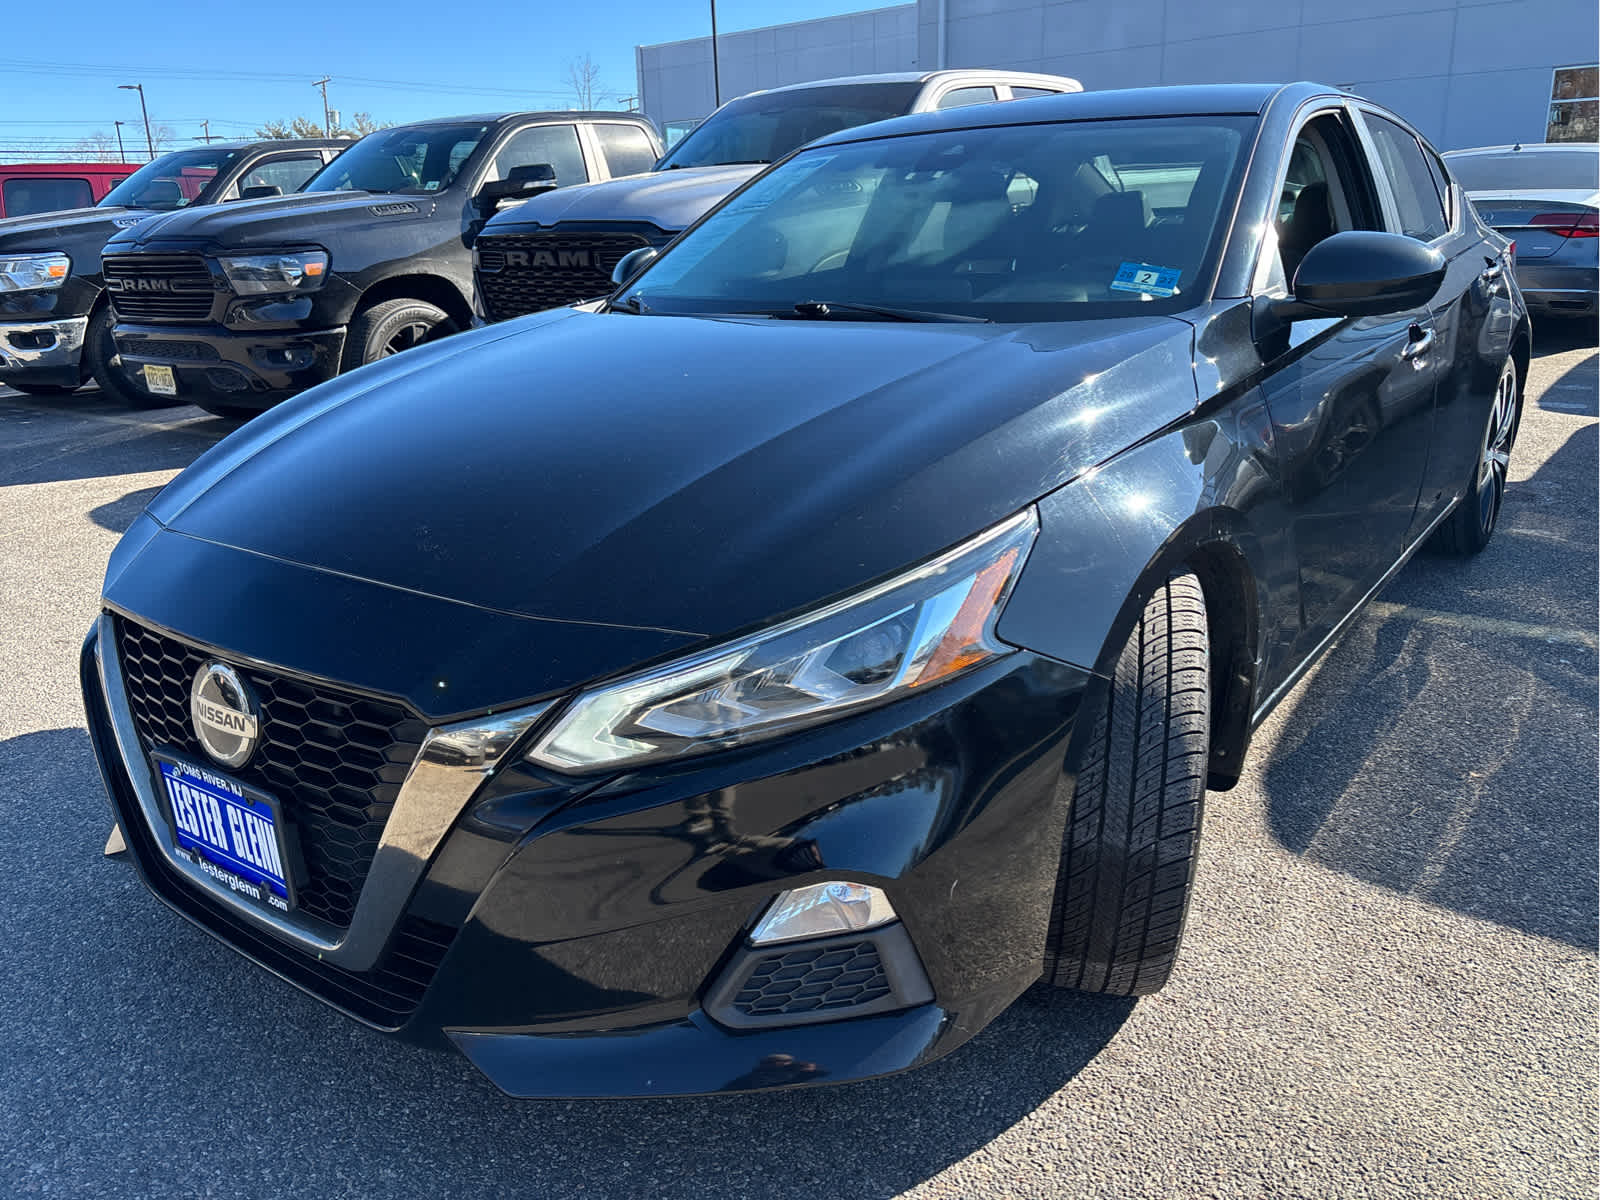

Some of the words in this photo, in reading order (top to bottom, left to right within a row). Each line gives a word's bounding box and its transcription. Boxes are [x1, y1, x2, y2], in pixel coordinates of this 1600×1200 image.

[505, 250, 591, 267] RAM
[123, 279, 170, 290] RAM
[1140, 273, 1152, 284] 2
[197, 702, 246, 732] NISSAN
[177, 761, 201, 780] TOMS
[230, 782, 242, 797] NJ
[165, 776, 230, 851] LESTER
[226, 803, 285, 880] GLENN
[198, 857, 261, 899] lesterglenn
